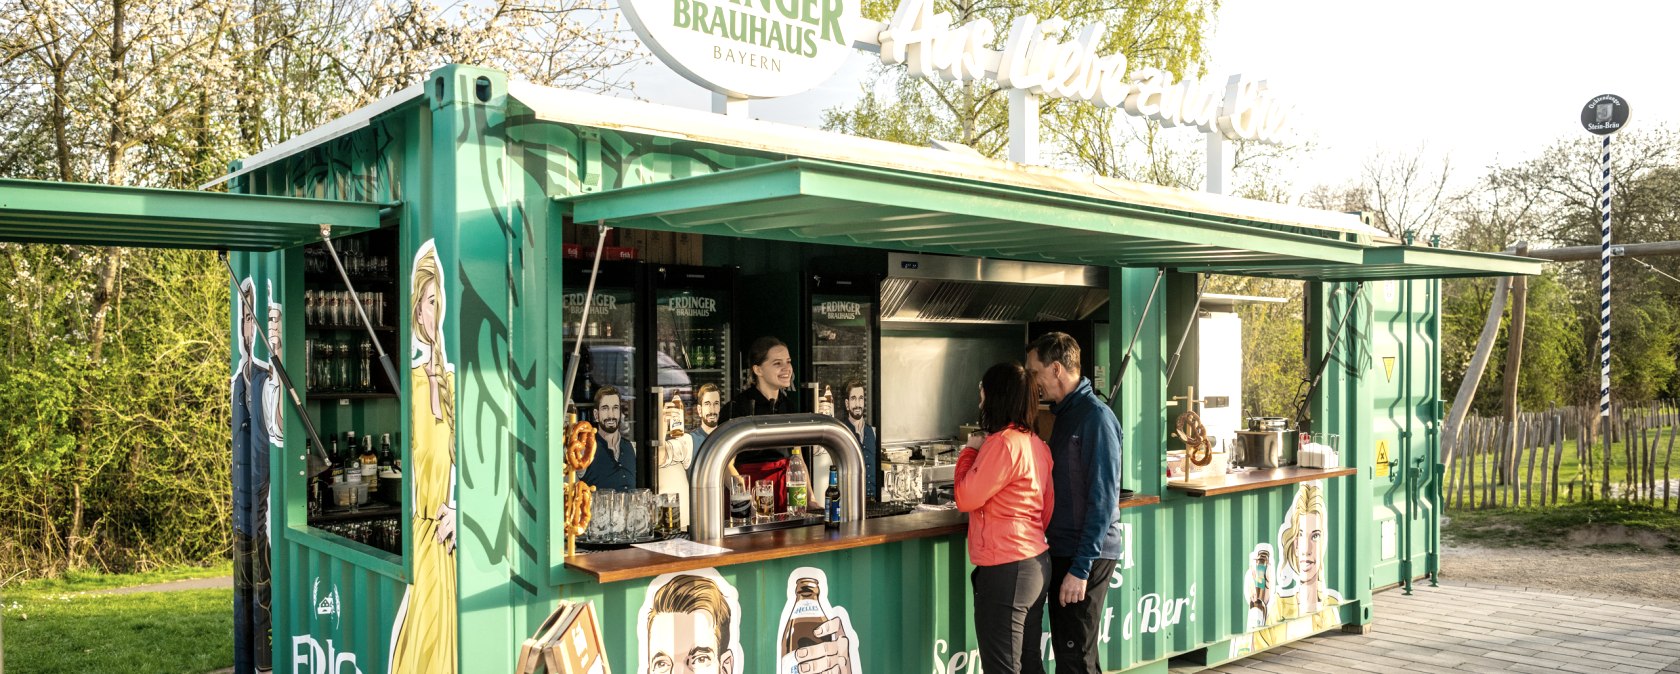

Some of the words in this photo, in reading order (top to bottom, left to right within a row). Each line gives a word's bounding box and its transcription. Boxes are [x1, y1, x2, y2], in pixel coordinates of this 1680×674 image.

[673, 0, 818, 58] BRAUHAUS
[713, 45, 781, 72] BAYERN
[1002, 13, 1130, 106] Liebe
[1223, 73, 1300, 144] Bie
[571, 305, 609, 315] BRAHAUS
[668, 296, 717, 312] ERDINGER
[821, 301, 861, 315] ERDINGER
[676, 308, 710, 317] BRAUHAUS
[827, 312, 856, 320] BRAUHAUS
